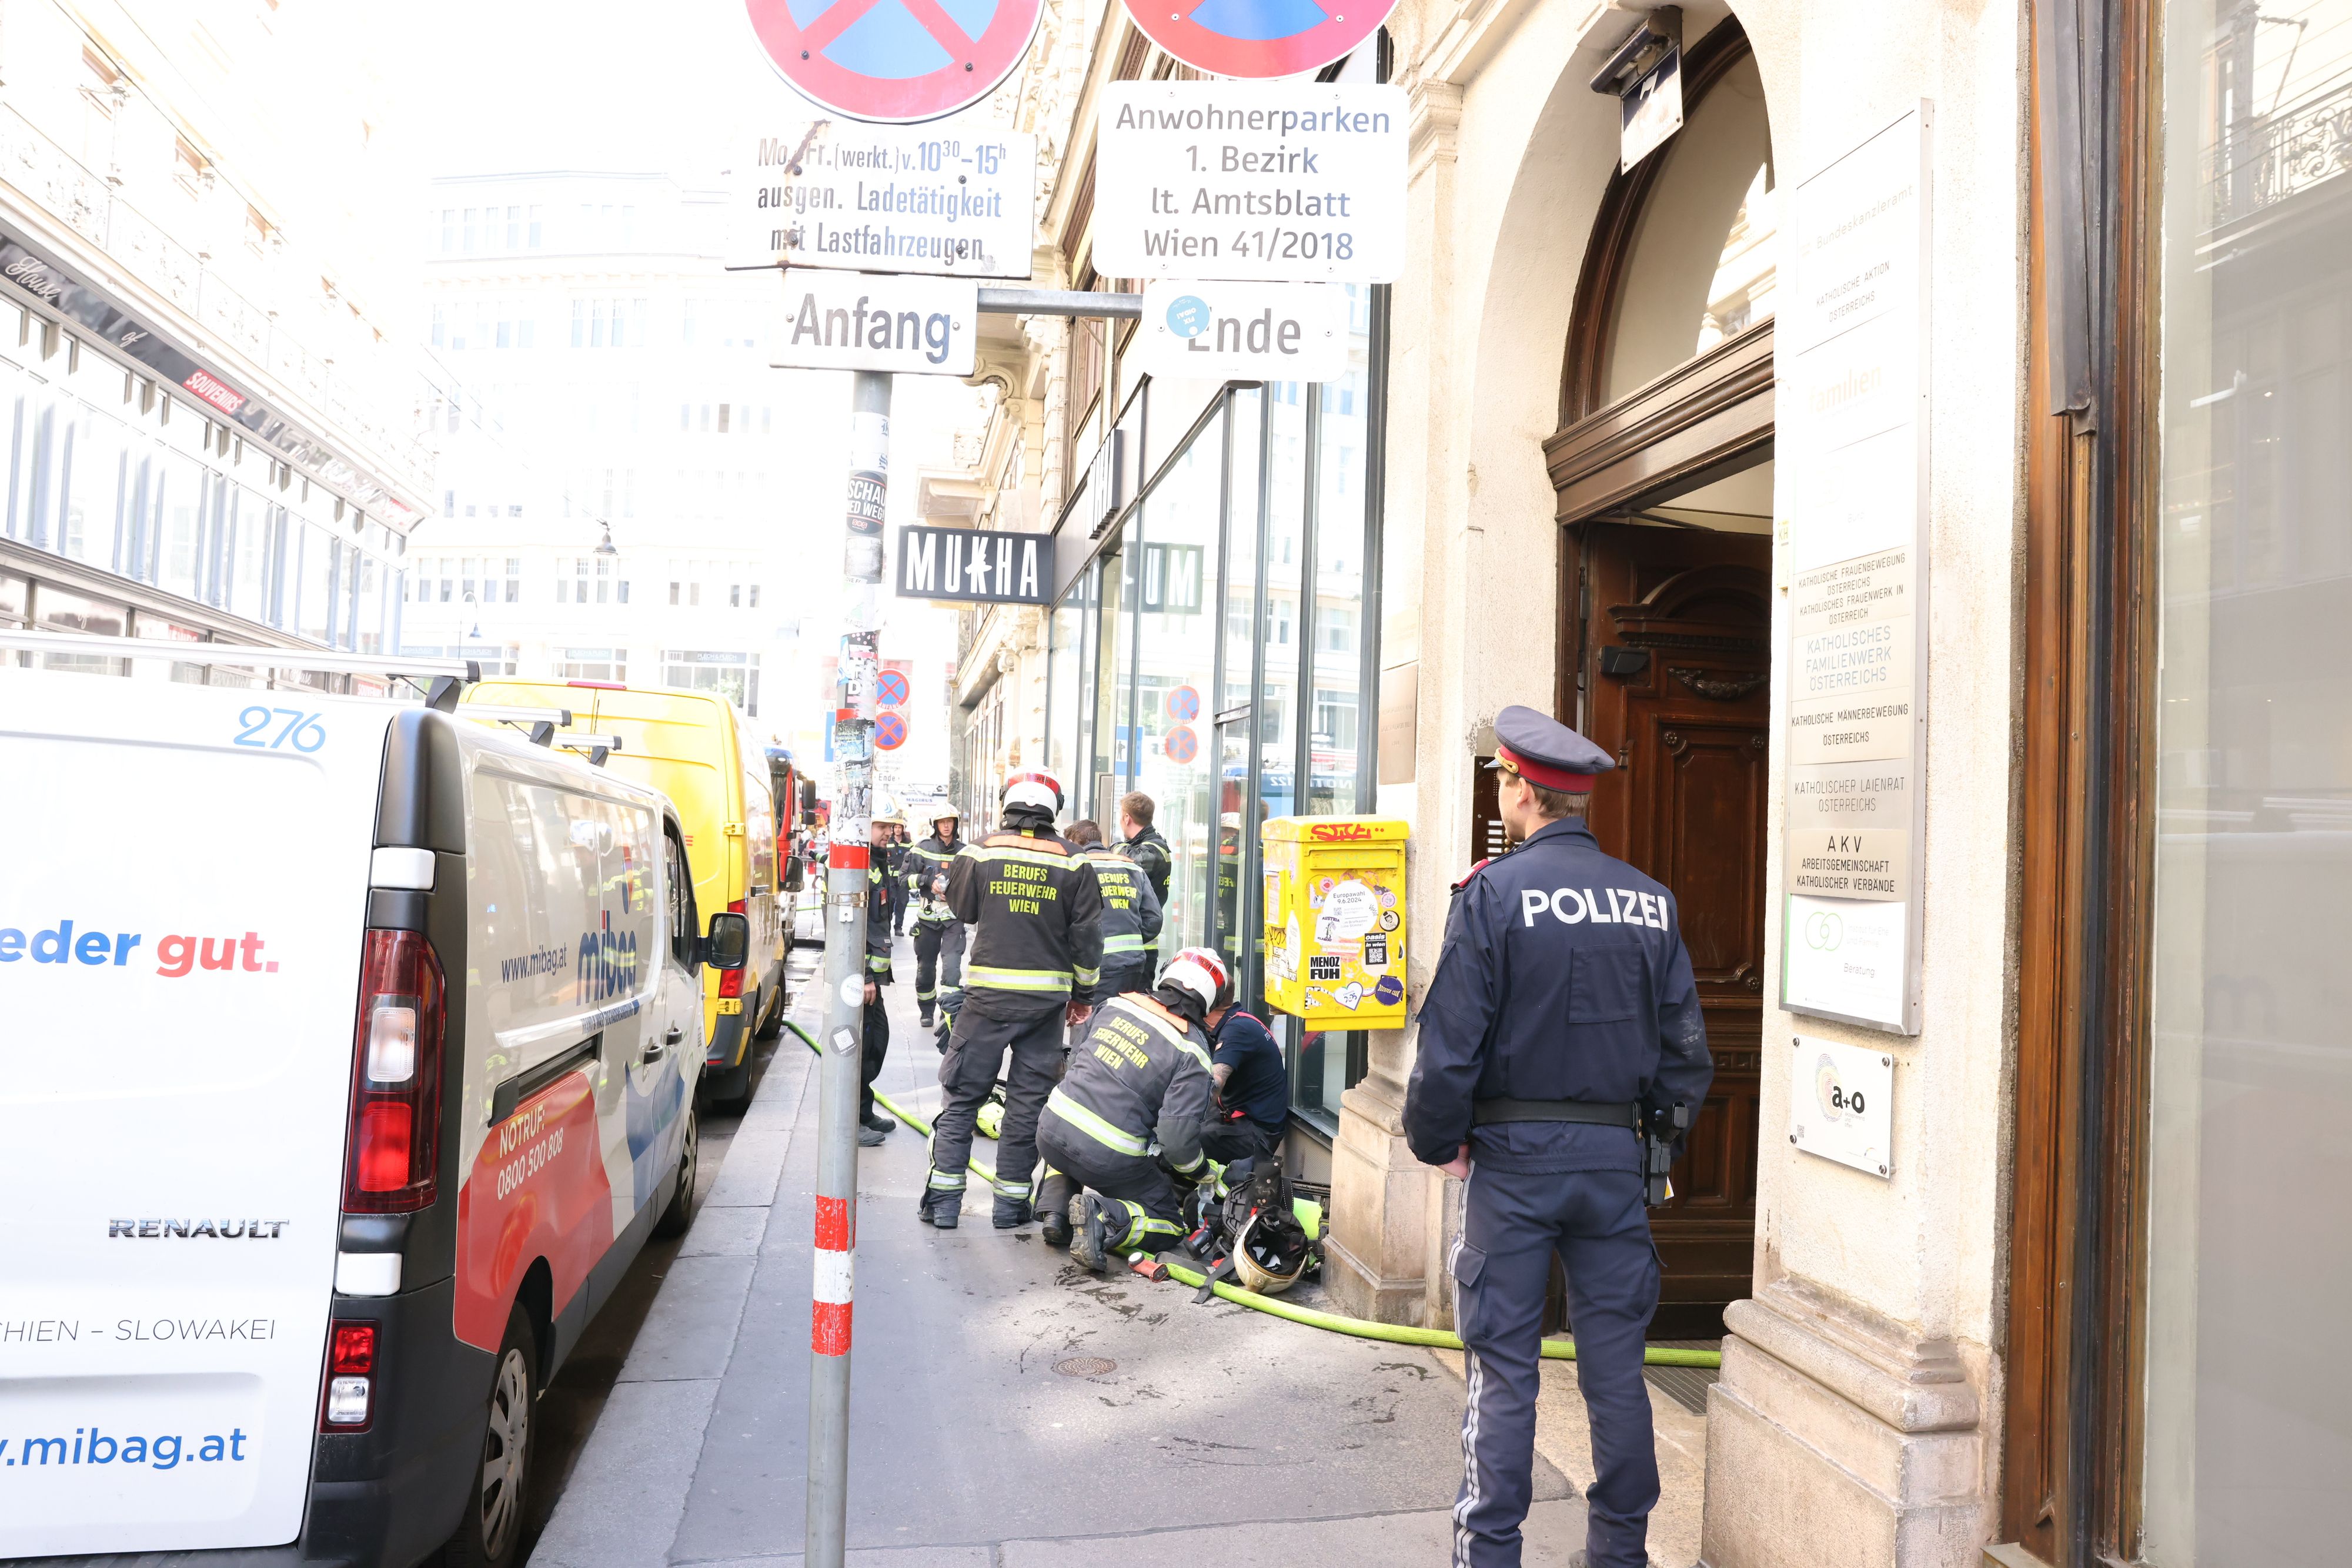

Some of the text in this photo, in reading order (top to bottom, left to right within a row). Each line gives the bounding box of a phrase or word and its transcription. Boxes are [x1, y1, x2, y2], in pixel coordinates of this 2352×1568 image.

[1116, 103, 1390, 137] Anwohnerparken
[1186, 145, 1319, 174] 1. Bezirk
[758, 181, 1002, 222] ausgen. Ladetätigkeit
[1152, 188, 1351, 218] lt. Amtsblatt
[1817, 183, 1913, 249] Bundeskanzleramt
[817, 222, 984, 266] Lastfahrzeugen
[1144, 228, 1353, 262] Wien 41/2018
[5, 256, 61, 301] House
[1816, 260, 1890, 308] KATHOLISCHE AKTION
[1828, 290, 1876, 323] ÖSTERREICHS
[120, 330, 147, 349] of
[792, 293, 951, 365] Anfang
[186, 370, 243, 414] SOUVENIRS
[1809, 366, 1882, 414] familien
[848, 479, 887, 507] SCHAU
[863, 502, 884, 521] WEG!
[906, 531, 1038, 598] MUKHA
[1798, 552, 1905, 589] KATHOLISCHE FRAUENBEWEGUNG
[1827, 576, 1870, 596] ÖSTERREICHS
[1800, 584, 1904, 617] KATHOLISCHES FRAUENWERK IN
[1829, 607, 1868, 625] ÖSTERREICH
[1807, 625, 1891, 655] KATHOLISCHES
[1806, 646, 1892, 674] FAMILIENWERK
[1809, 666, 1887, 692] ÖSTERREICHS
[877, 702, 901, 711] ANFANG
[1792, 703, 1909, 728] KATHOLISCHE MÄNNERBEWEGUNG
[233, 706, 326, 753] 276
[1823, 731, 1869, 746] ÖSTERREICHS
[878, 773, 896, 782] Ende
[1795, 777, 1905, 795] KATHOLISCHER LAIENRAT
[1003, 864, 1048, 882] BERUFS
[1099, 872, 1130, 885] BERUFS
[1802, 858, 1889, 874] ARBEITSGEMEINSCHAFT
[990, 881, 1057, 901] FEUERWEHR
[1333, 890, 1365, 899] Europawahl
[1797, 874, 1895, 893] KATHOLISCHER VERBÄNDE
[1009, 899, 1040, 915] WIEN
[1110, 897, 1130, 910] WIEN
[1521, 887, 1668, 931] POLIZEI
[156, 932, 279, 978] gut.
[502, 942, 567, 984] www.mibag.at
[1310, 957, 1340, 968] MENOZ
[1310, 968, 1340, 979] FUH
[1844, 962, 1876, 978] Beratung
[1109, 1015, 1150, 1046] BERUFS
[1092, 1027, 1149, 1069] FEUERWEHR
[1094, 1045, 1124, 1070] WIEN
[1832, 1085, 1865, 1114] a+o
[500, 1104, 545, 1159] NOTRUF:
[497, 1126, 564, 1201] 0800 500 808
[108, 1218, 290, 1242] RENAULT
[0, 1320, 79, 1342] HIEN
[115, 1319, 275, 1340] SLOWAKEI
